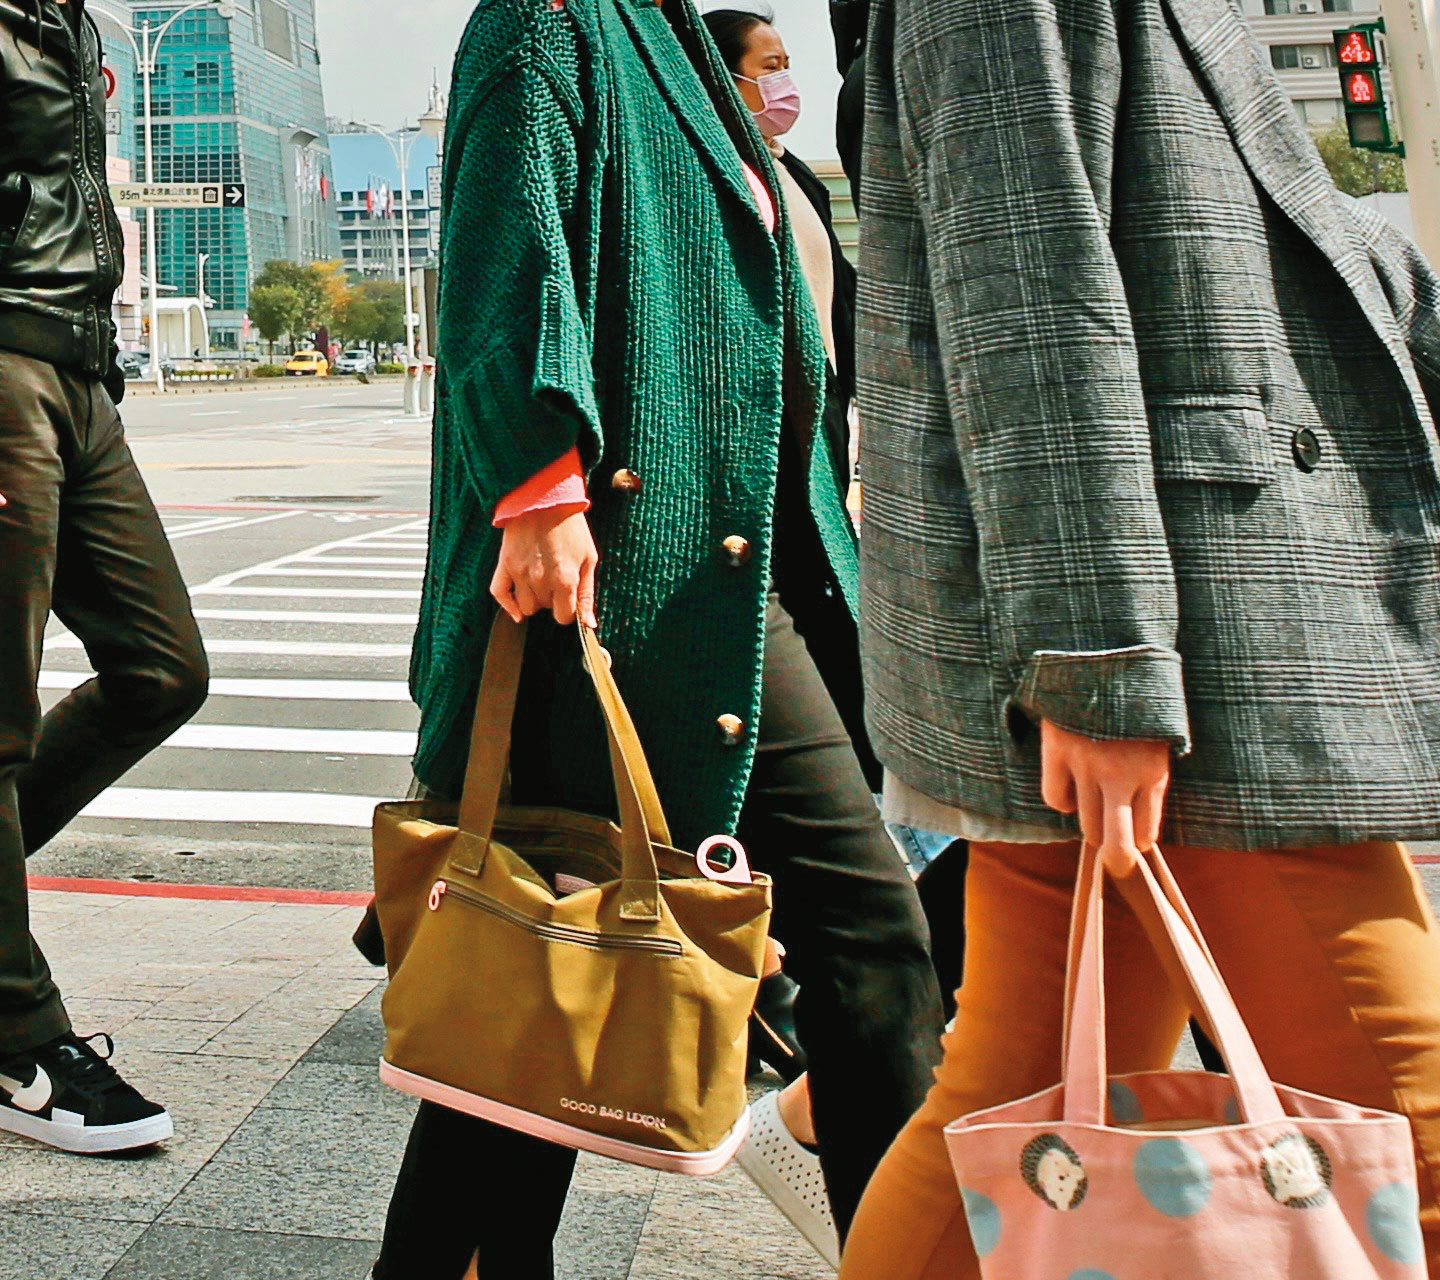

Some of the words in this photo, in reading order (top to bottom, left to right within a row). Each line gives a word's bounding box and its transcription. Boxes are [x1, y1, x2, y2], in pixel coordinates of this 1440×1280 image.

[120, 190, 140, 200] 95m
[560, 1098, 597, 1114] GOOD
[599, 1106, 624, 1120] BAG
[626, 1111, 667, 1129] LEXON
